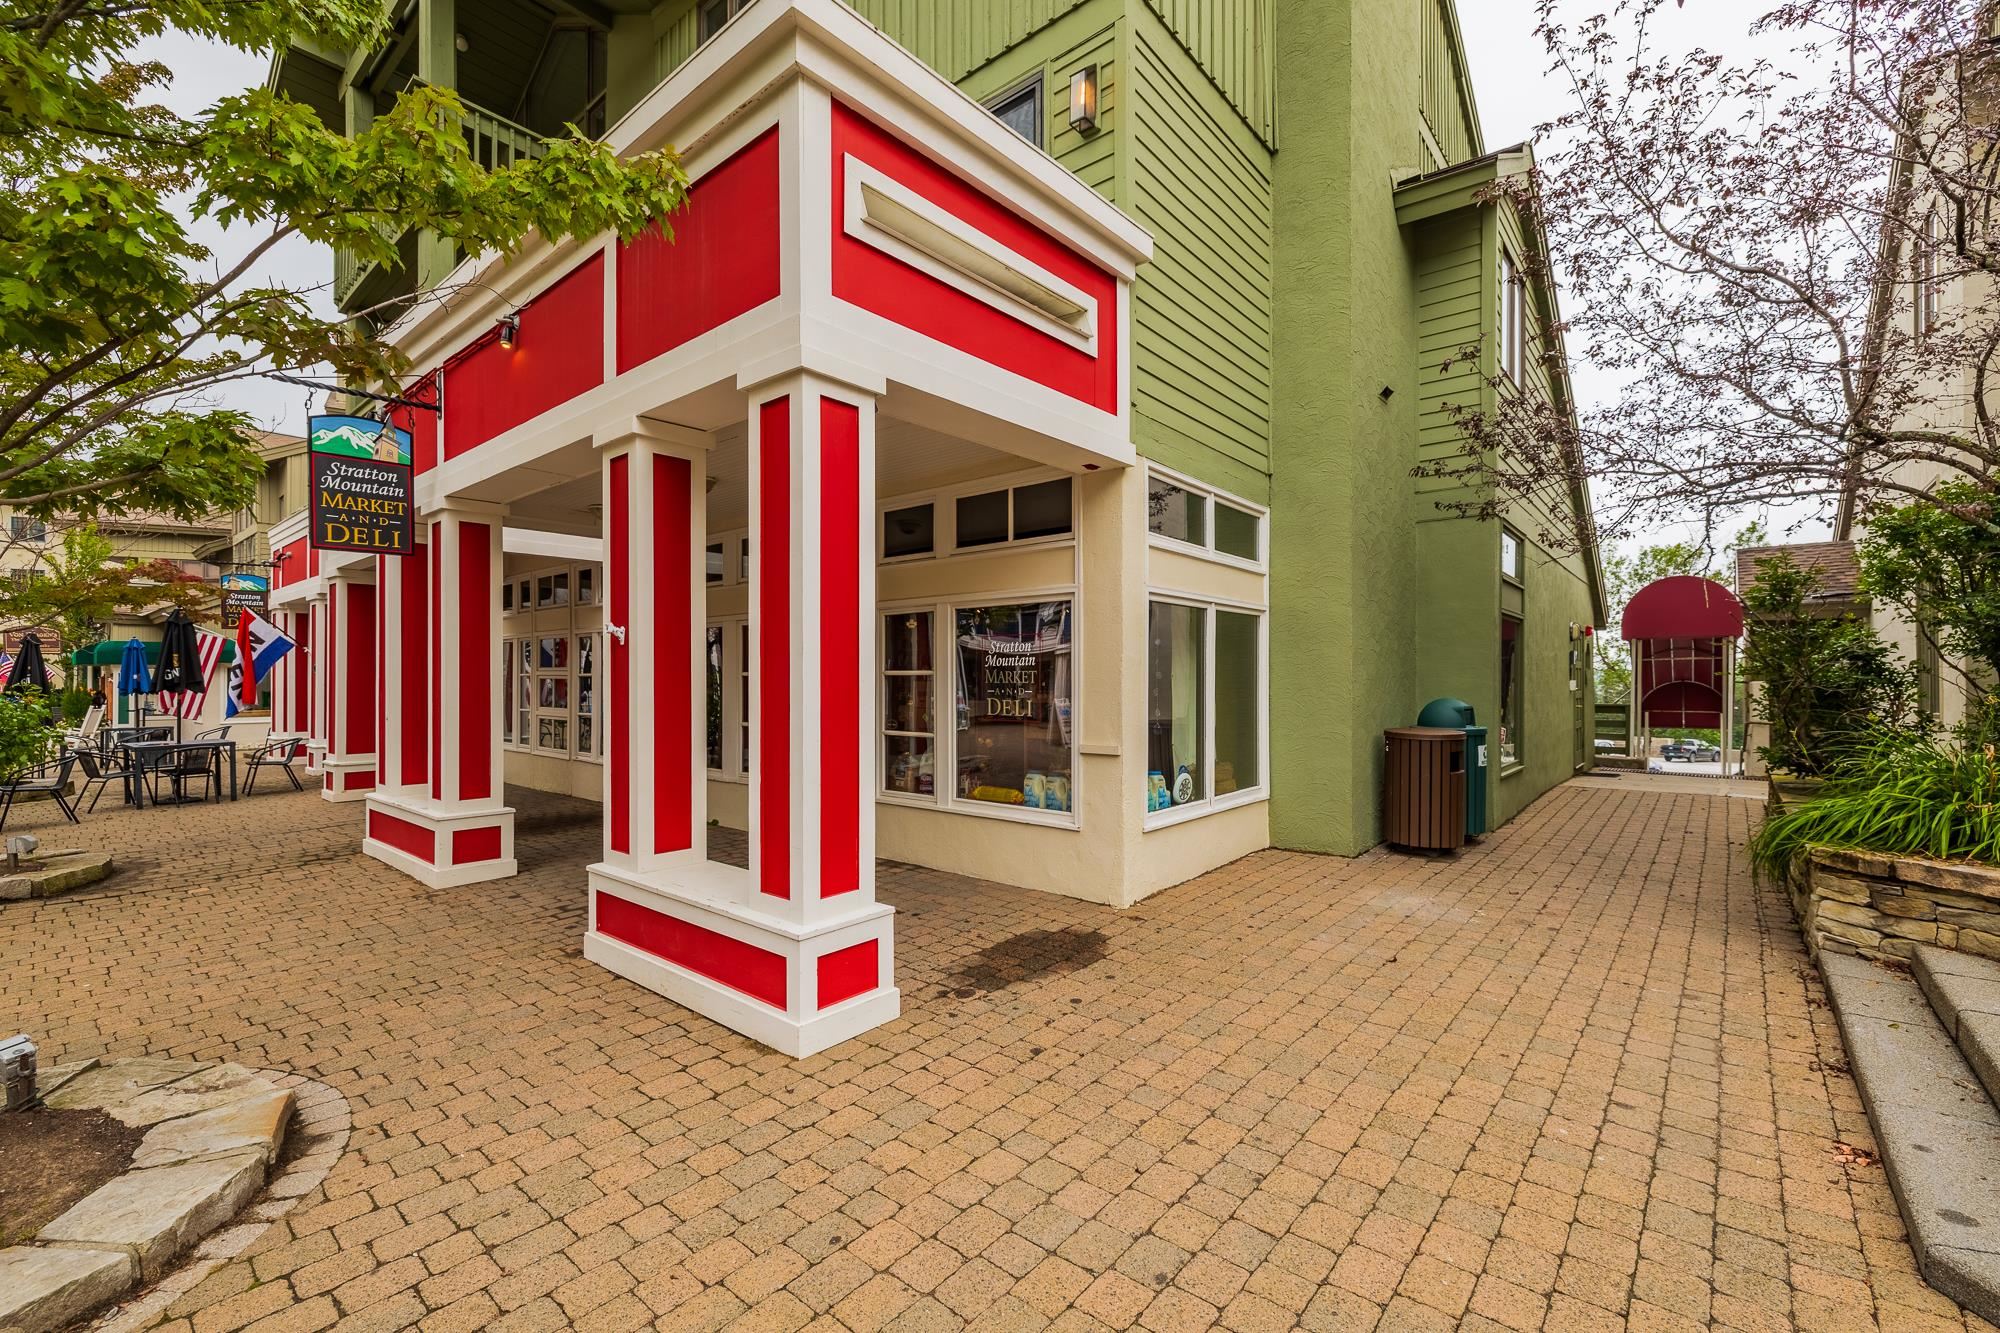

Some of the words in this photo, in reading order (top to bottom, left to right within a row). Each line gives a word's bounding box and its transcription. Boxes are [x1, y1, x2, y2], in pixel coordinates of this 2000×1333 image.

[327, 462, 398, 482] Stratton
[320, 475, 405, 497] Mountain
[320, 490, 408, 516] MARKET
[324, 522, 401, 548] DELI
[229, 592, 261, 600] Stratton
[226, 605, 266, 614] MAET
[988, 641, 1032, 654] Stratton
[984, 653, 1036, 667] Mountain
[985, 669, 1037, 684] MARKET
[987, 697, 1032, 717] DELI
